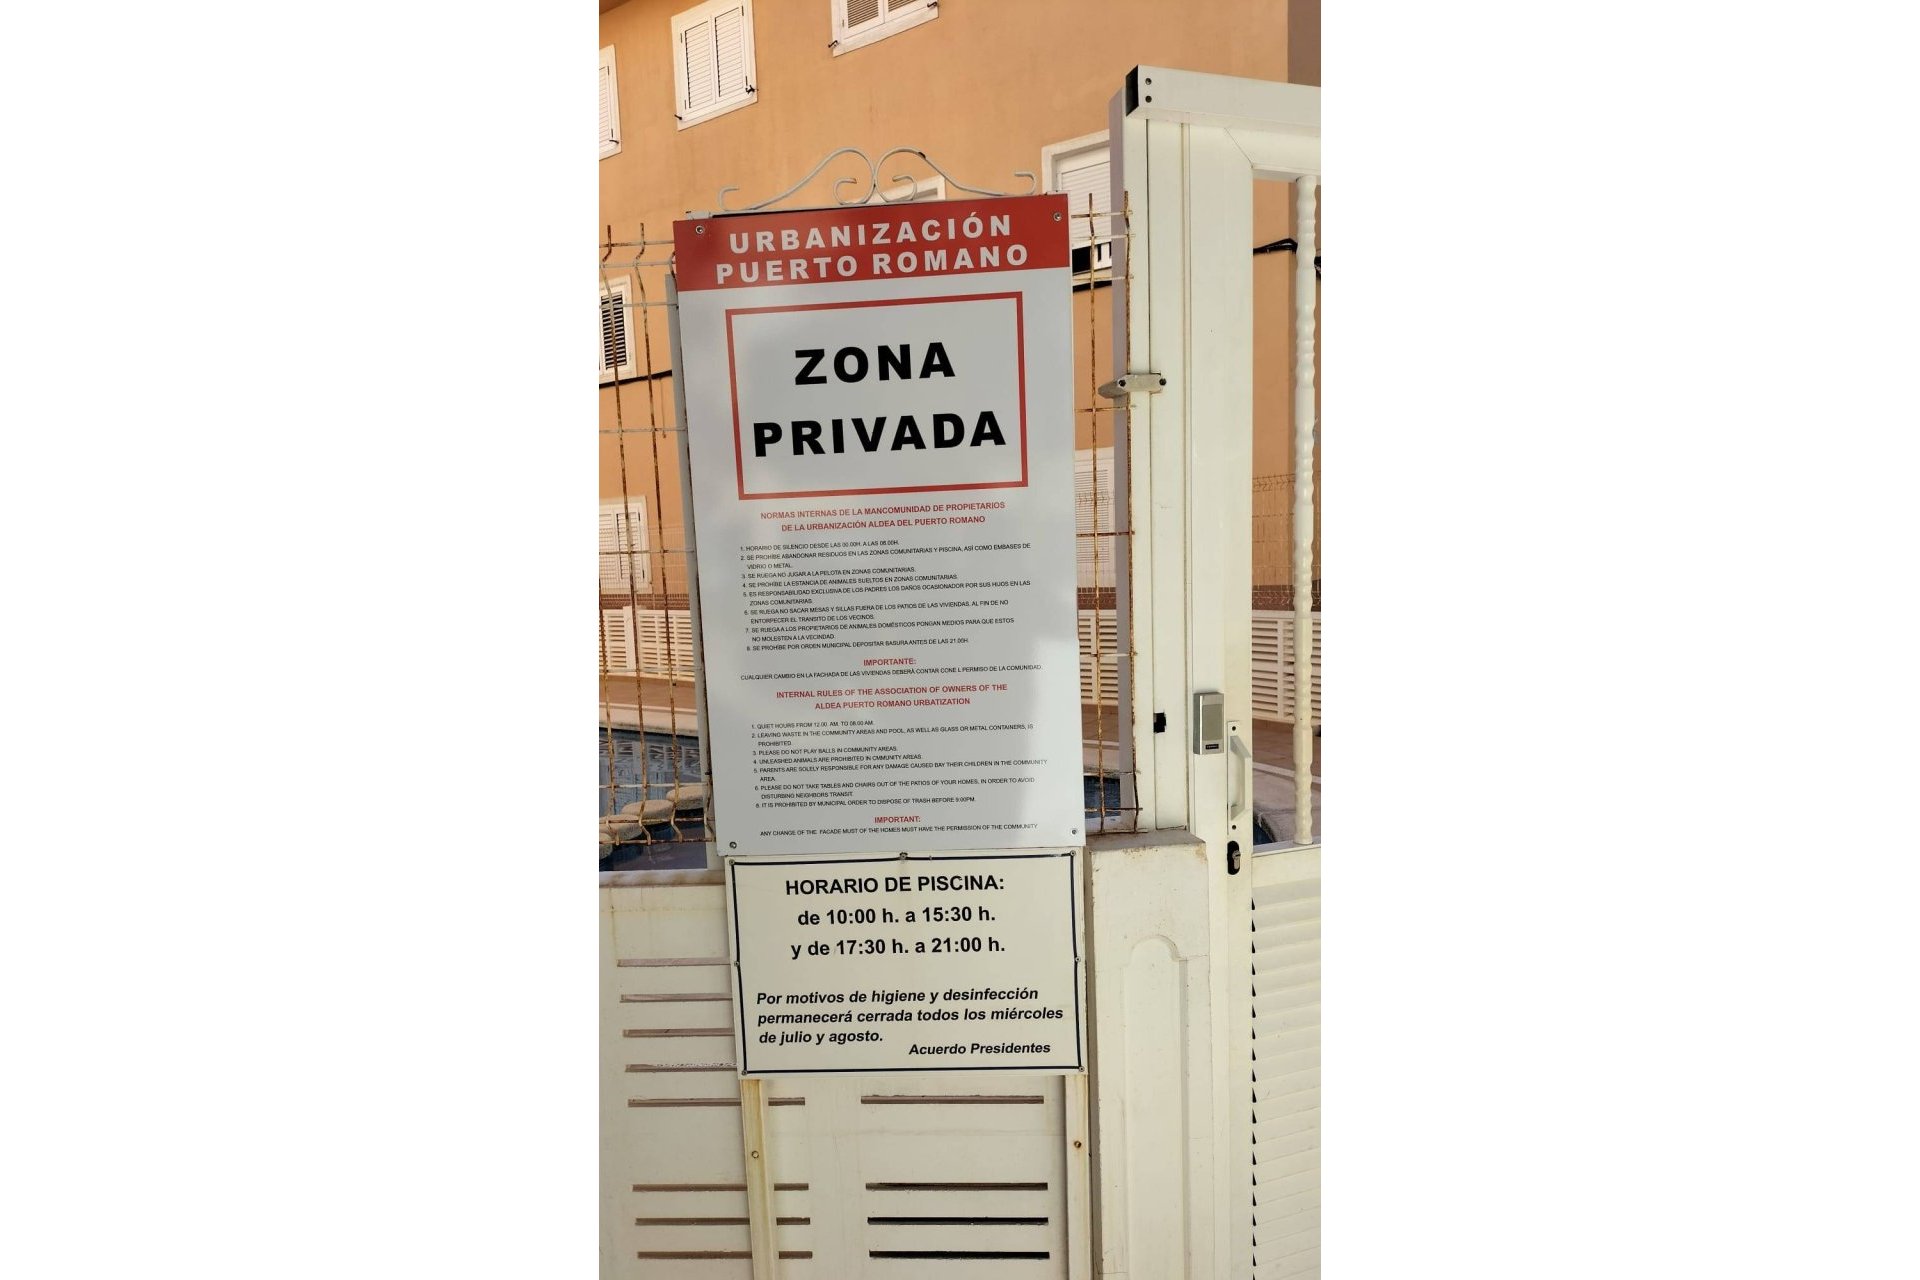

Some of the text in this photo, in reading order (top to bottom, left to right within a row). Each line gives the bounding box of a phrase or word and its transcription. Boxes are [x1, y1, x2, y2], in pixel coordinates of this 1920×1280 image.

[729, 212, 1012, 254] URBANIZACIÓN
[716, 244, 1029, 285] PUERTO ROMANO
[795, 342, 955, 385] ZONA
[754, 411, 1005, 457] PRIVADA
[760, 511, 795, 519] NORMAS
[796, 509, 837, 518] INTERNAS
[838, 508, 850, 516] DE
[863, 505, 931, 515] MANCOMUNIDAD
[945, 501, 1005, 511] PROPIETARIOS
[793, 523, 805, 531] LA
[805, 519, 866, 530] URBANIZACIÓN
[867, 519, 895, 527] ALDEA
[896, 518, 913, 526] DEL
[913, 517, 947, 525] PUERTO
[948, 515, 985, 524] ROMANO
[900, 582, 921, 590] DAÑOS
[863, 657, 916, 666] IMPORTANTE:
[776, 690, 815, 698] INTERNAL
[874, 686, 927, 694] ASSOCIATION
[876, 699, 912, 707] ROMANO
[912, 698, 970, 706] URBATIZATION
[874, 815, 920, 823] IMPORTANT:
[786, 875, 1003, 895] HORARIO DE PISCINA:
[798, 906, 995, 925] de 10:00 h. a 15:30 h.
[791, 937, 1004, 960] y de 17:30 h. a 21:00 h.
[757, 988, 1038, 1004] Por motivos de higiene y desinfección
[758, 1007, 1063, 1027] permanecerá cerrada todos los miércoles
[759, 1031, 882, 1046] de julio y agosto.
[909, 1043, 1050, 1054] Acuerdo Presidentes
